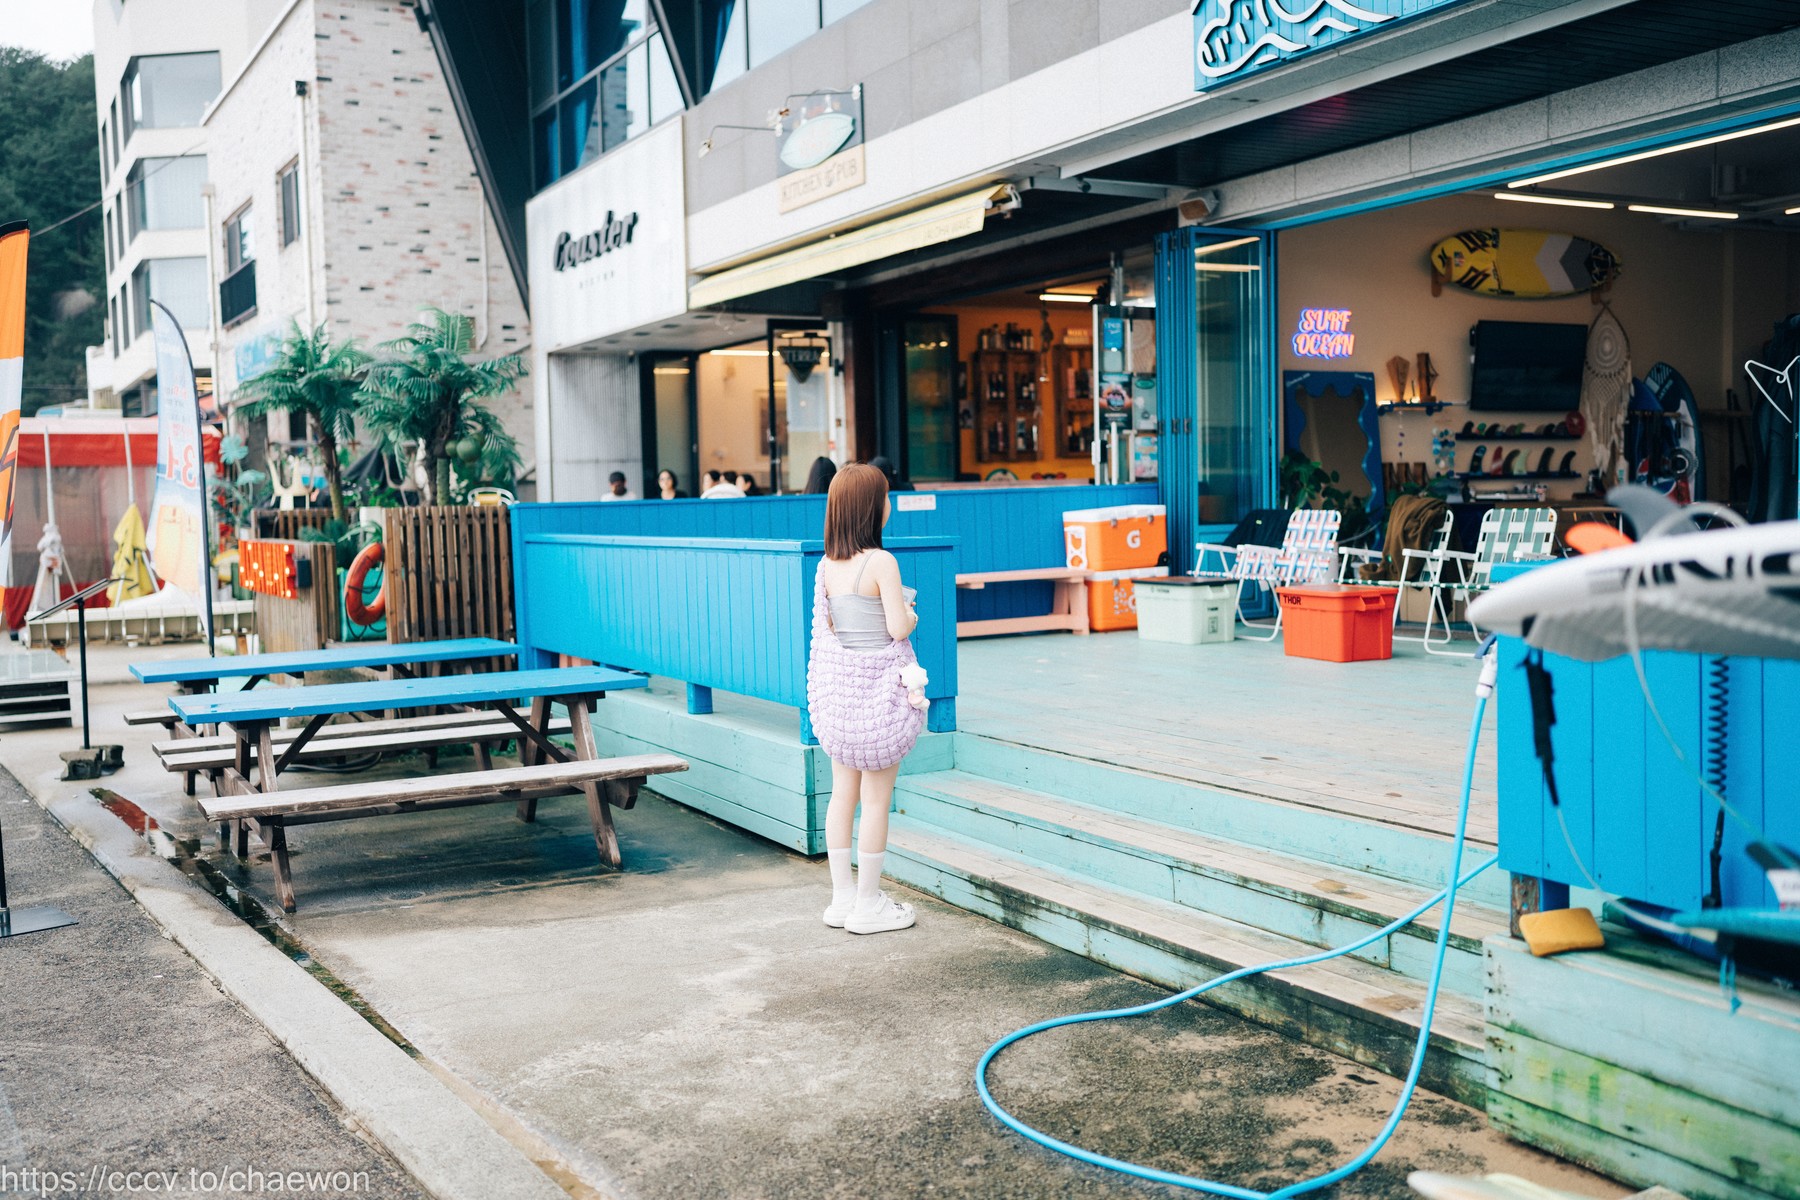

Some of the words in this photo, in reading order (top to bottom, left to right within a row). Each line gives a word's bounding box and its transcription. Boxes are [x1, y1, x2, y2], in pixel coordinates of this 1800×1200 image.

[1301, 308, 1352, 332] SURF
[1293, 333, 1355, 358] OCEAN
[1126, 529, 1141, 548] G
[1283, 594, 1301, 606] THOR
